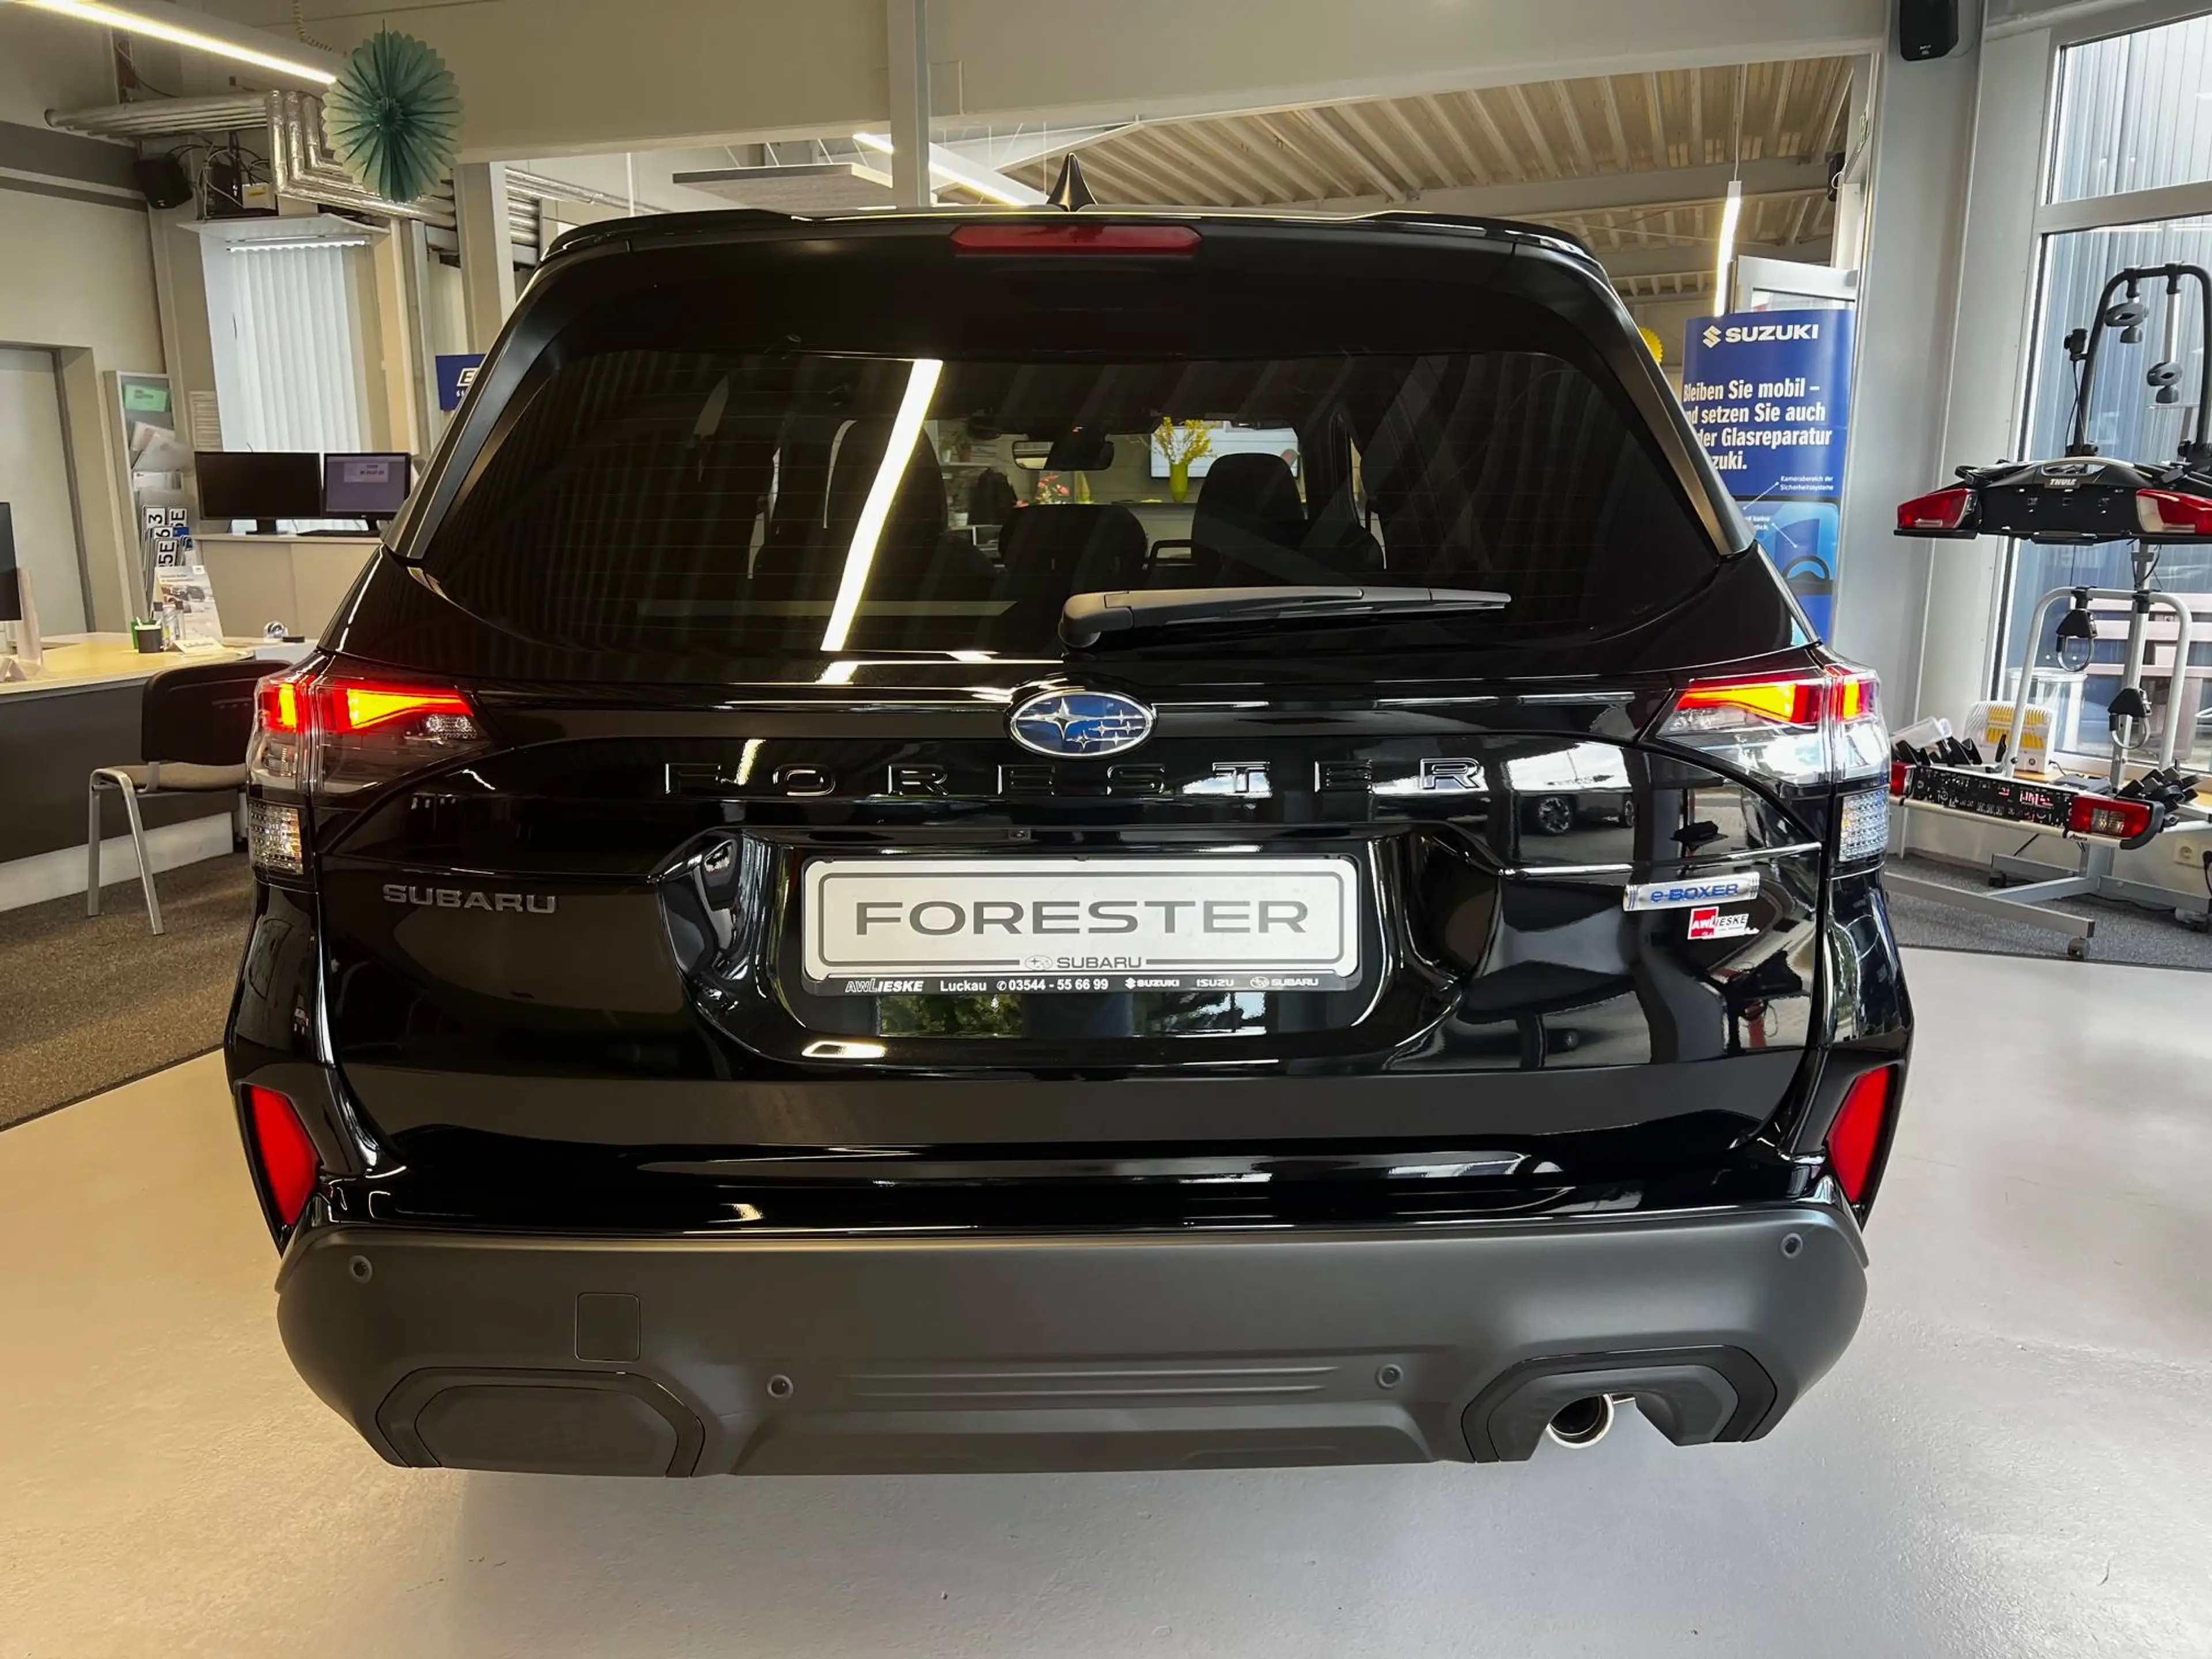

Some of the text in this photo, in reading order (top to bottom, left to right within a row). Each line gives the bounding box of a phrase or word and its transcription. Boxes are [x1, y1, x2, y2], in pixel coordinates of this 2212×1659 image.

[1725, 324, 1819, 342] SUZUKI
[1683, 382, 1724, 402] Bleiben
[1728, 380, 1753, 399] Sie
[1758, 377, 1805, 397] mobil
[1685, 402, 1825, 425] nd setzen Sie auch
[1721, 427, 1832, 449] Glasreparatur
[665, 757, 1490, 796] FORESTER
[382, 883, 556, 914] SUBARU
[1650, 883, 1738, 902] e-BOXER
[856, 901, 1308, 935] FORESTER
[1056, 956, 1142, 968] SUBARU
[845, 979, 924, 993] AWLIESKE
[940, 980, 987, 992] Luckau
[1009, 979, 1046, 991] 03544
[1056, 979, 1072, 990] 55
[1075, 979, 1090, 990] 66
[1093, 979, 1109, 990] 99
[1271, 978, 1319, 986] SUBARU
